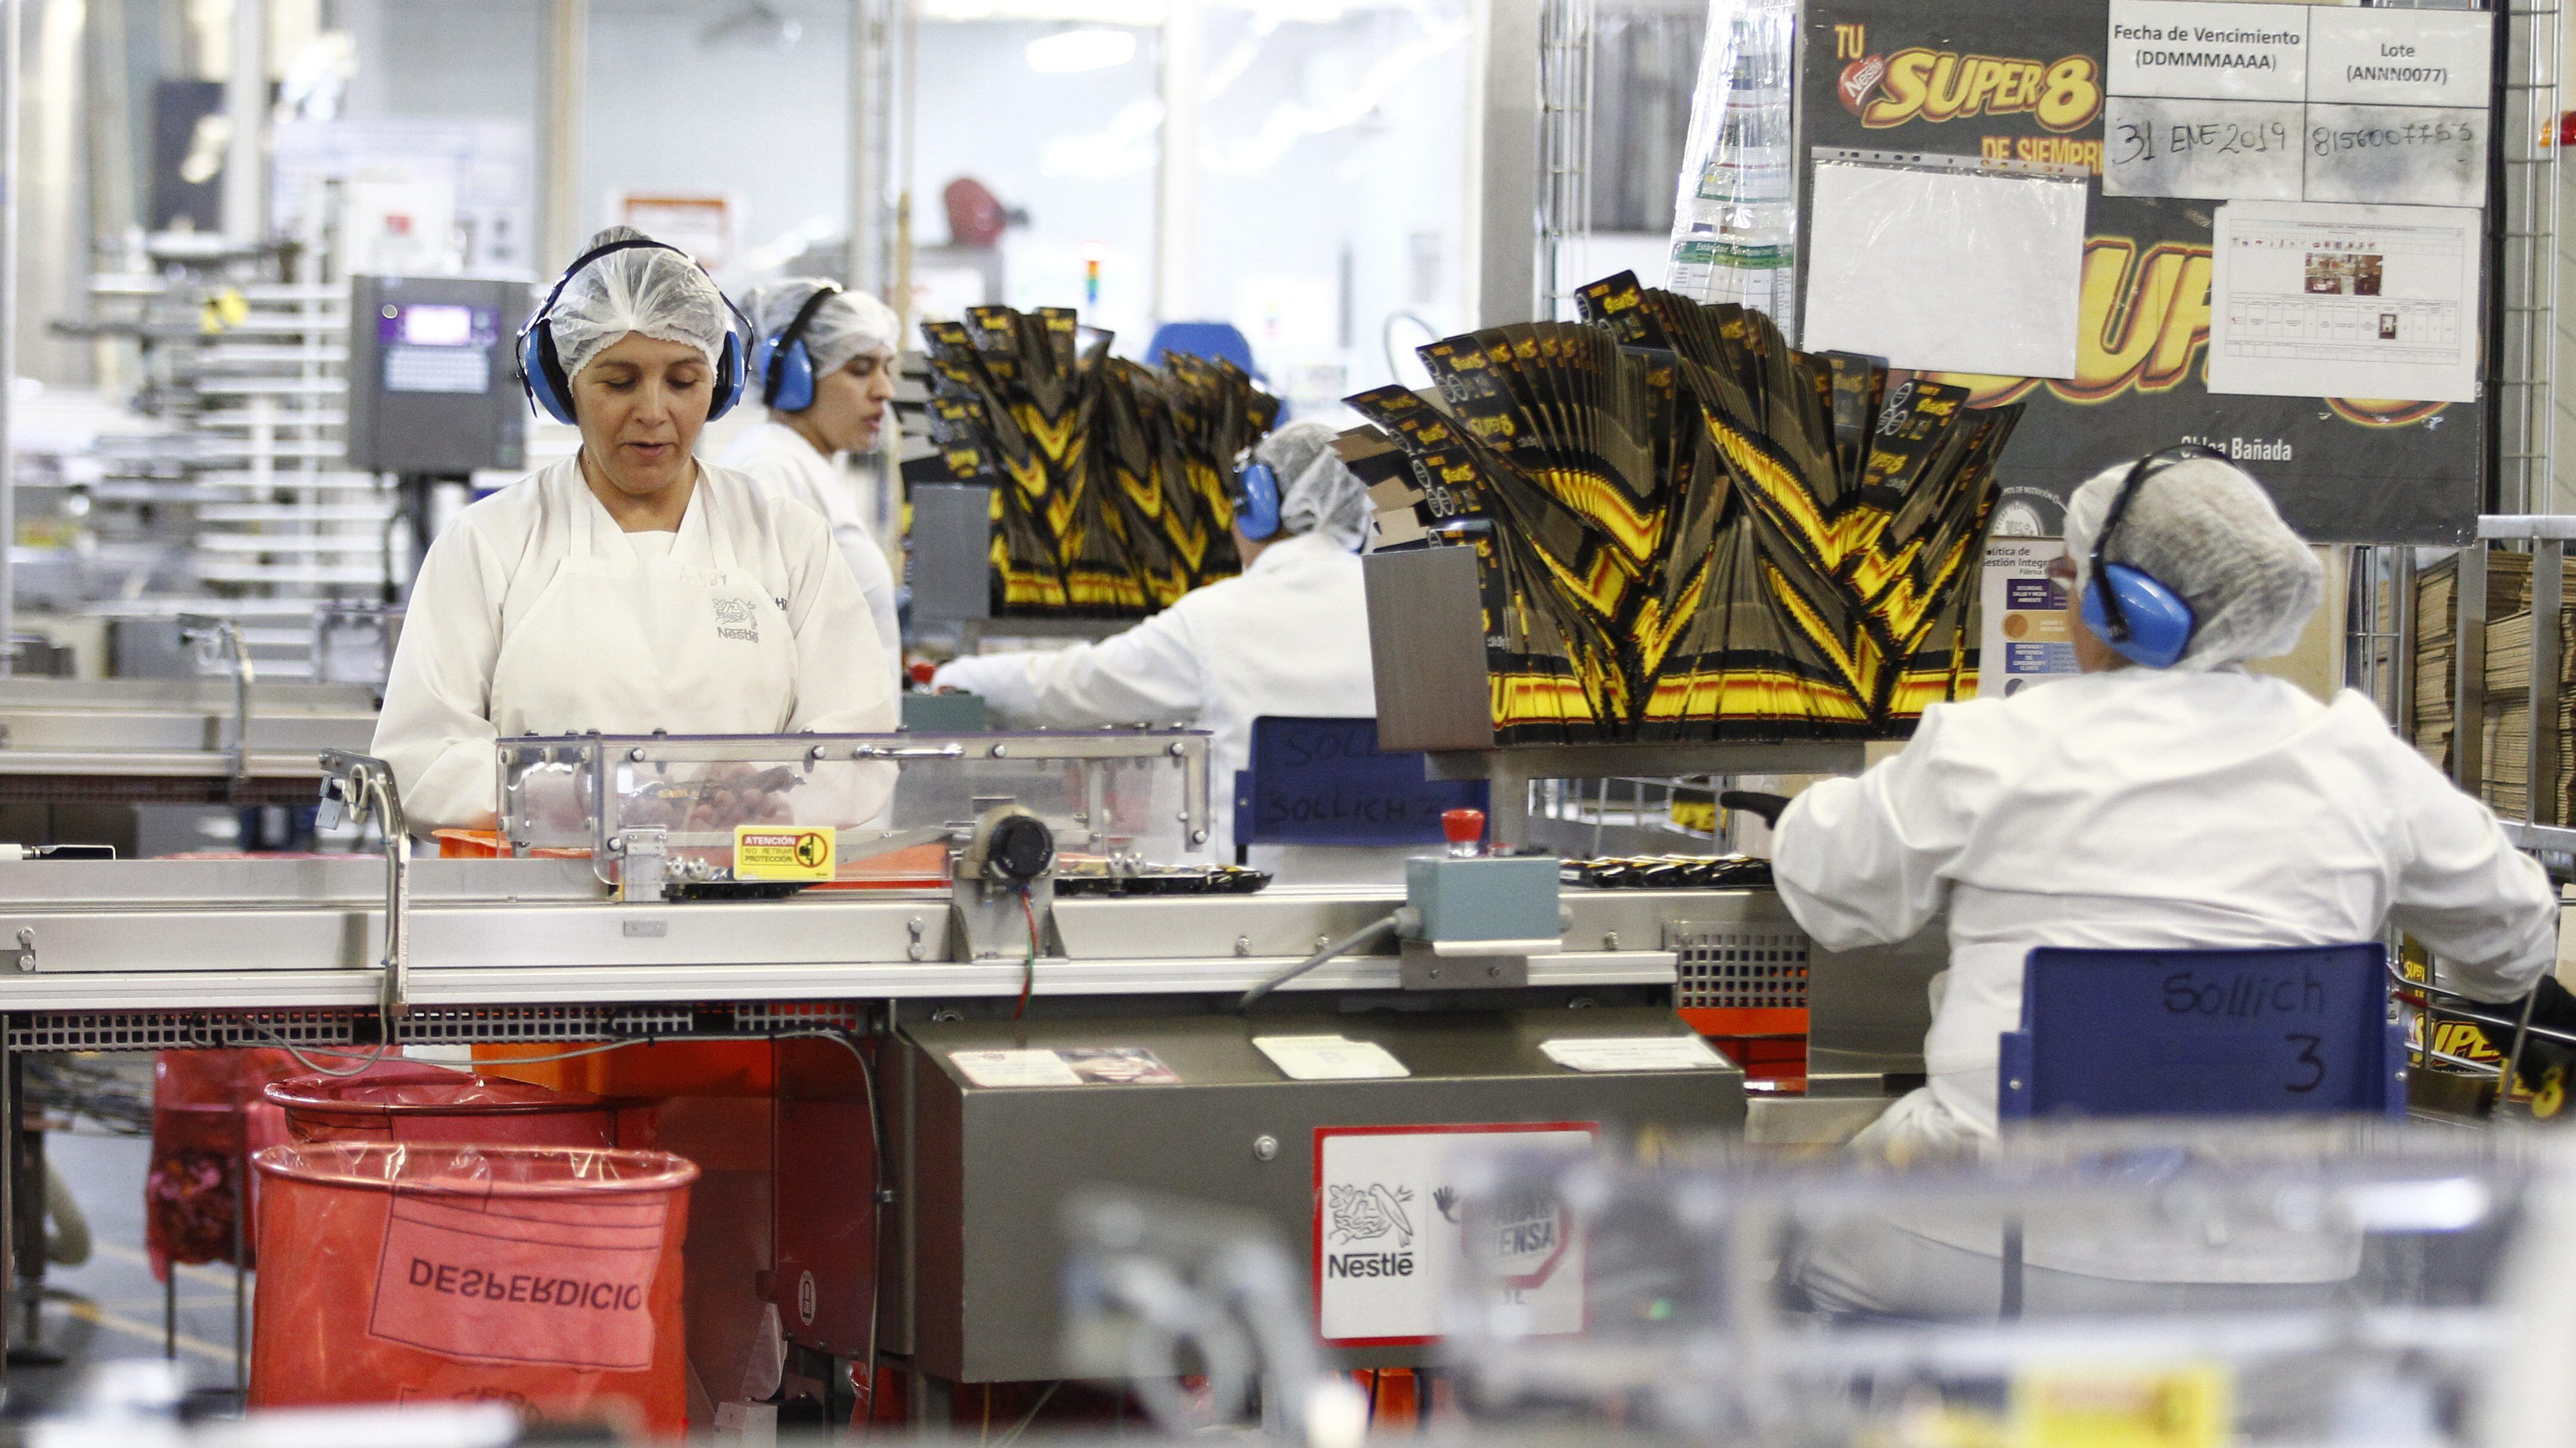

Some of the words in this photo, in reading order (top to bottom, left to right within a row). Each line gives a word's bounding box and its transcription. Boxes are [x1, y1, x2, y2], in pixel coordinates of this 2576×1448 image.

[1834, 23, 1865, 60] TU
[2114, 25, 2162, 40] Fecha
[2168, 26, 2188, 41] de
[2194, 27, 2300, 45] Vencimiento
[2136, 49, 2277, 72] (DDMMMAAAA)
[2381, 44, 2415, 57] Lote
[2347, 65, 2447, 85] (ANNN0077)
[1982, 136, 2012, 160] DE
[2112, 119, 2155, 165] 31
[2170, 124, 2219, 153] ENE
[2219, 122, 2285, 154] 2019
[2231, 437, 2293, 460] Bañada
[745, 836, 796, 845] ATENCIÓN
[2284, 1032, 2325, 1093] 3
[1328, 1251, 1414, 1279] Nestlé
